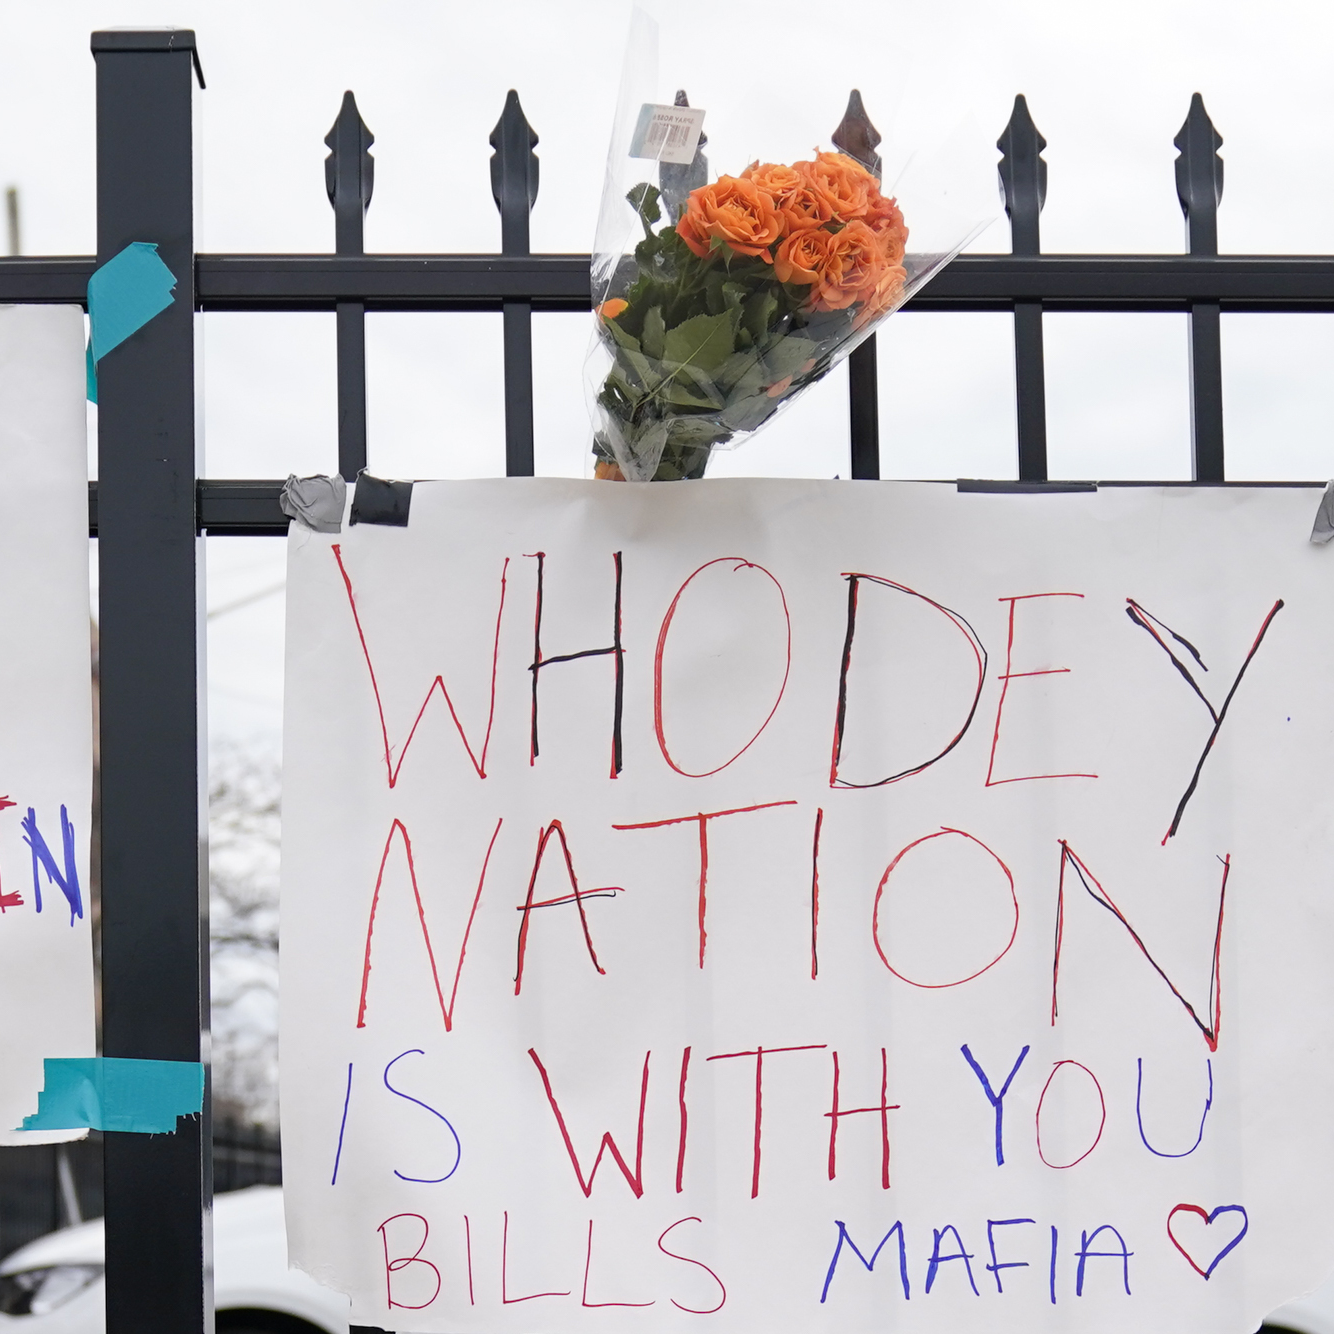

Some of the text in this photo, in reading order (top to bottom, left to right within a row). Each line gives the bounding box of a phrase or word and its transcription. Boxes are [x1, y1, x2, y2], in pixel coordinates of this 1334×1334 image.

[332, 544, 1285, 846] WHODEY
[357, 800, 1231, 1051] NATION
[331, 1043, 1213, 1198] IS WITH YOU
[376, 1210, 1134, 1314] BILLS MAFIA
